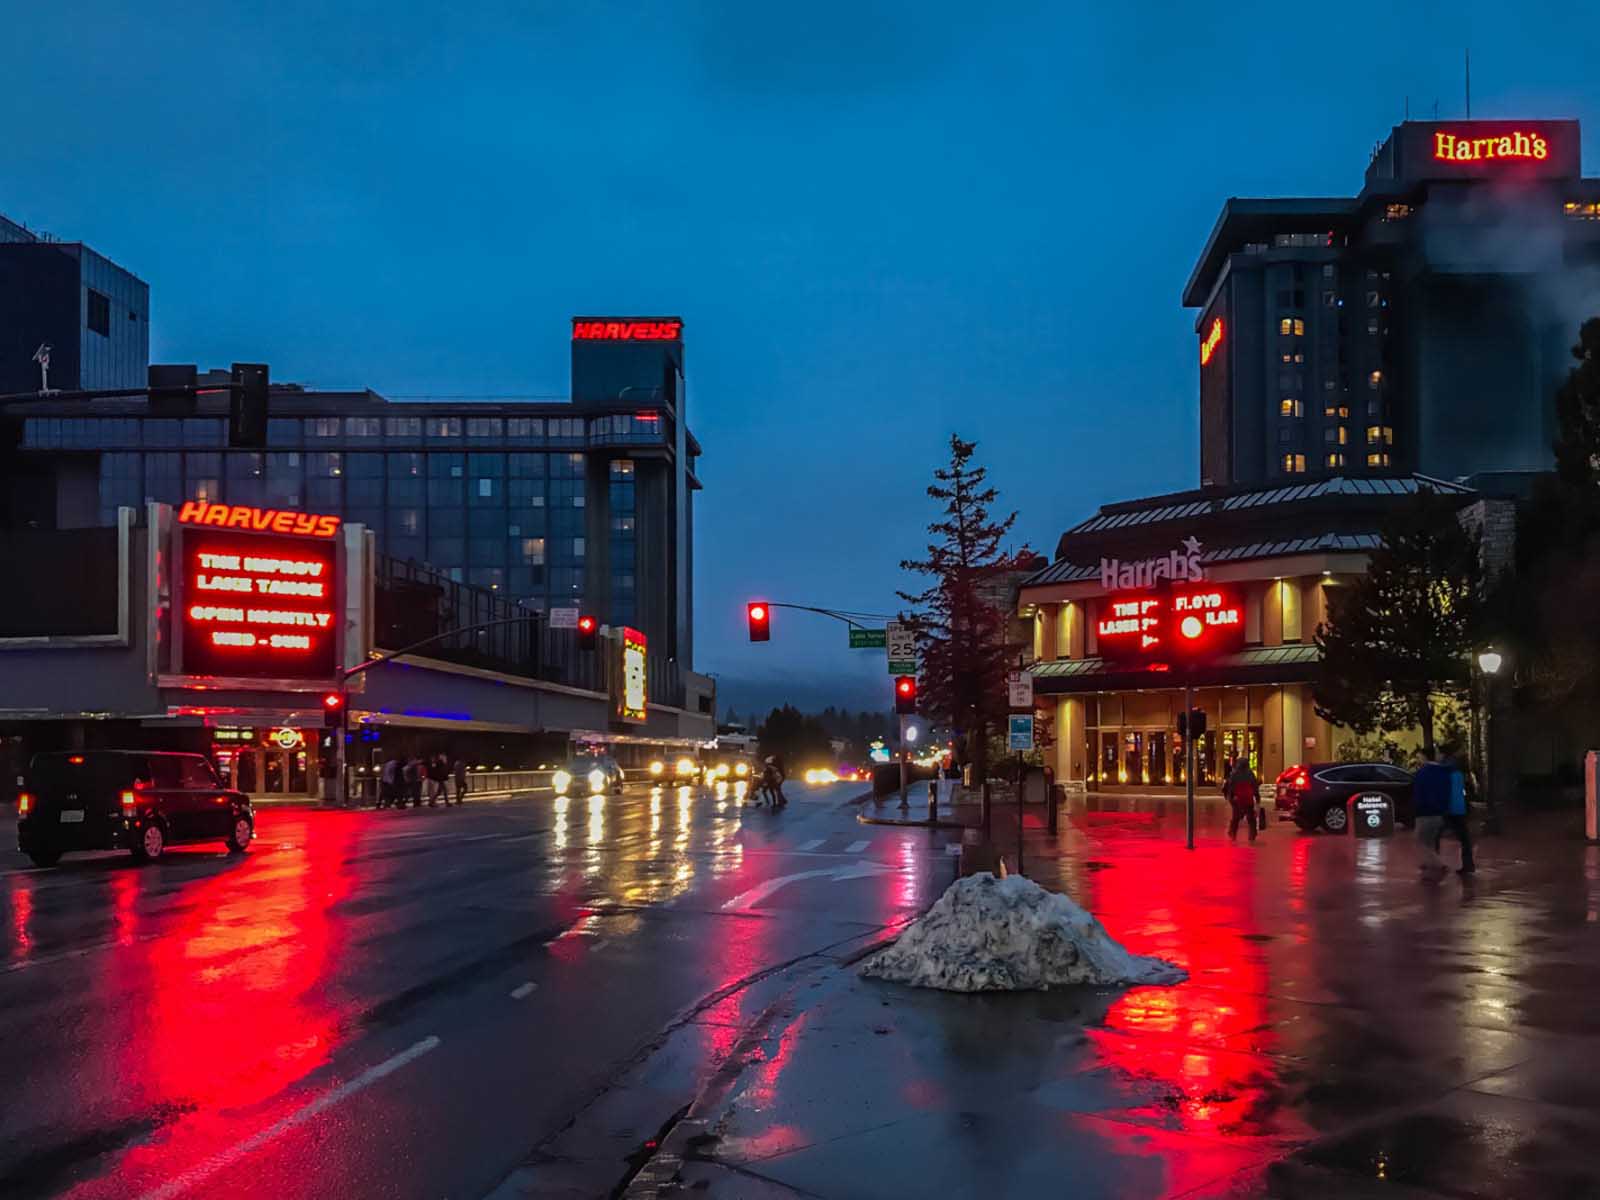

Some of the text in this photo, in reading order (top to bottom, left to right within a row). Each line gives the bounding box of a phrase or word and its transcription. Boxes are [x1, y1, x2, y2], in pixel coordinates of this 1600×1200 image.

[1435, 131, 1547, 160] Harrah's
[574, 322, 681, 340] HARVEYS
[178, 500, 341, 537] HARVEYS
[198, 552, 241, 571] THE
[196, 574, 324, 597] LAKE TAHOE
[189, 605, 331, 628] OPEN NIGHTLY
[1112, 601, 1140, 617] THE
[891, 643, 913, 656] 25
